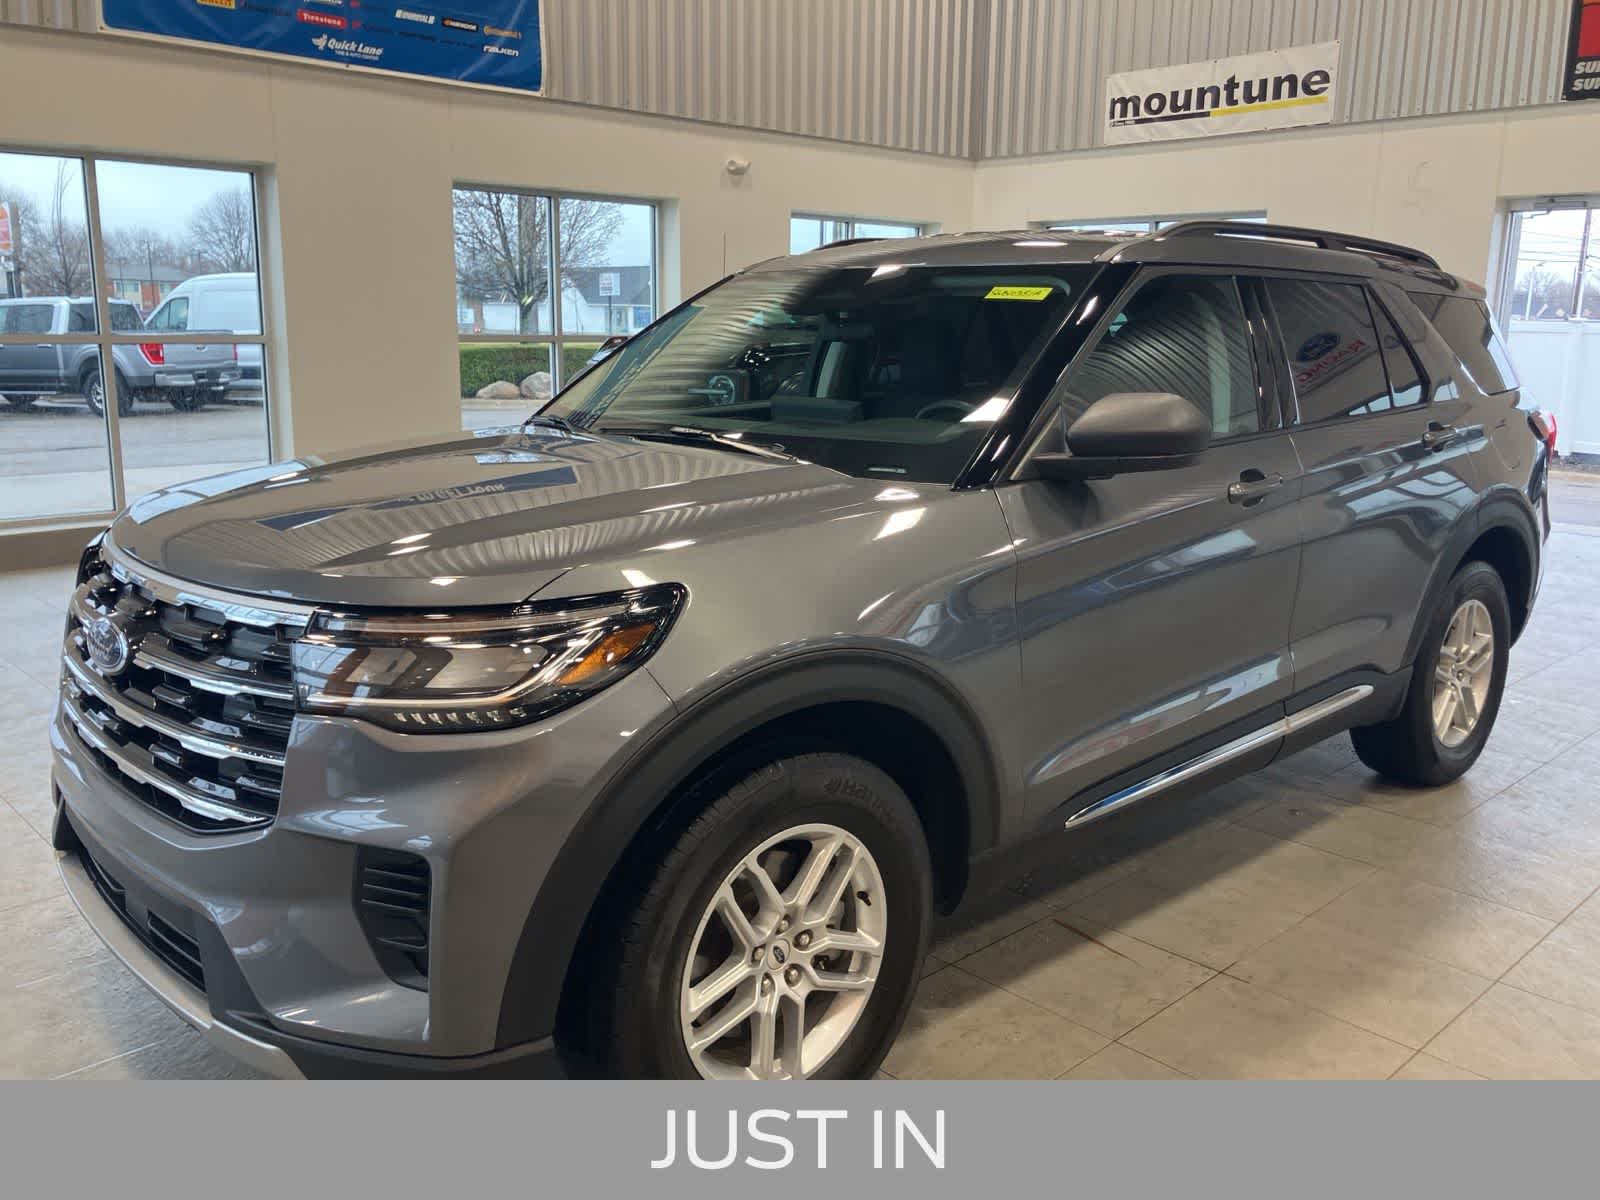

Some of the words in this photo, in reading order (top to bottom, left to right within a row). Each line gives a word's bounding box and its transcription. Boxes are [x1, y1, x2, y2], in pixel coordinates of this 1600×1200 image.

[327, 37, 357, 52] Quick
[357, 42, 384, 56] Lane
[1109, 69, 1331, 120] mountune
